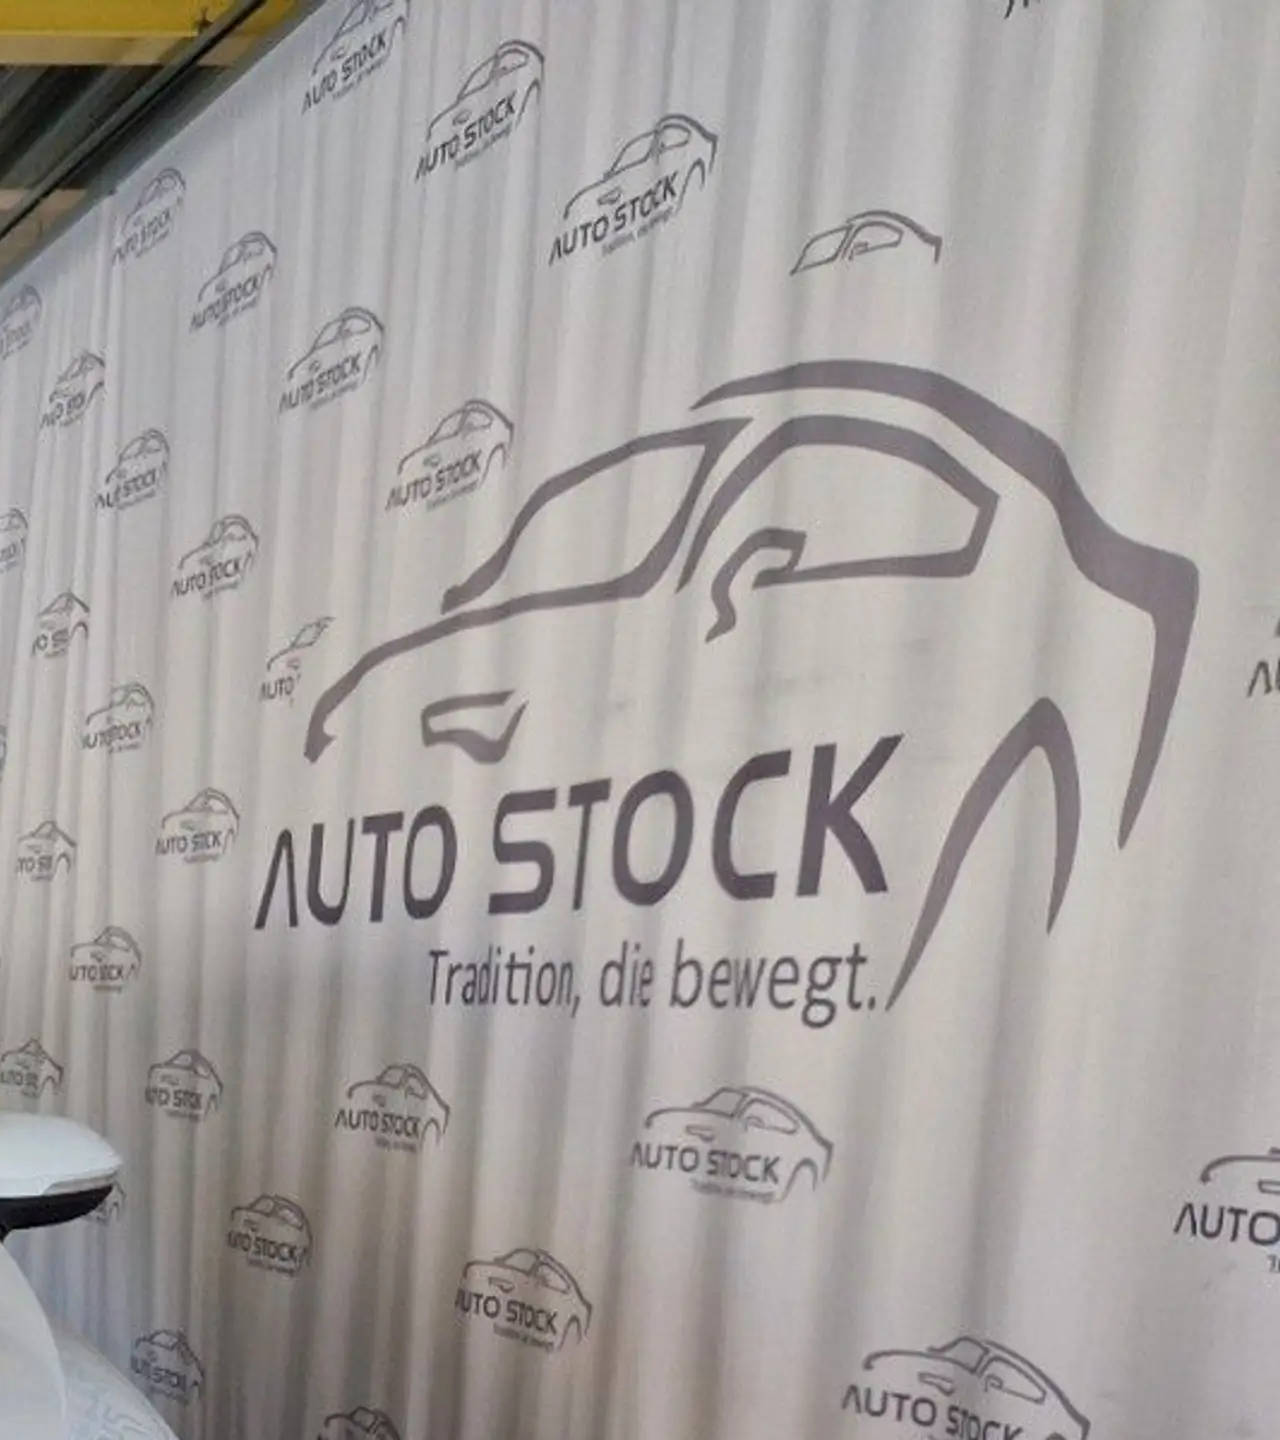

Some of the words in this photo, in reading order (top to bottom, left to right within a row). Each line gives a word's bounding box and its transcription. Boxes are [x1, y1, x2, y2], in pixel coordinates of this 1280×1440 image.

[548, 214, 609, 267] AUTO
[614, 170, 679, 232] STOCK
[254, 804, 458, 930] AUTO
[488, 732, 904, 915] STOCK
[428, 944, 581, 1018] Tradition,
[599, 940, 654, 1007] die
[670, 937, 877, 1029] bewegt.
[334, 1107, 380, 1132] AUTO
[630, 1140, 700, 1173] AUTO
[705, 1149, 781, 1184] STOCK
[1173, 1201, 1280, 1247] AUTO
[504, 1299, 559, 1336] STOCK
[841, 1383, 938, 1427] AUTO
